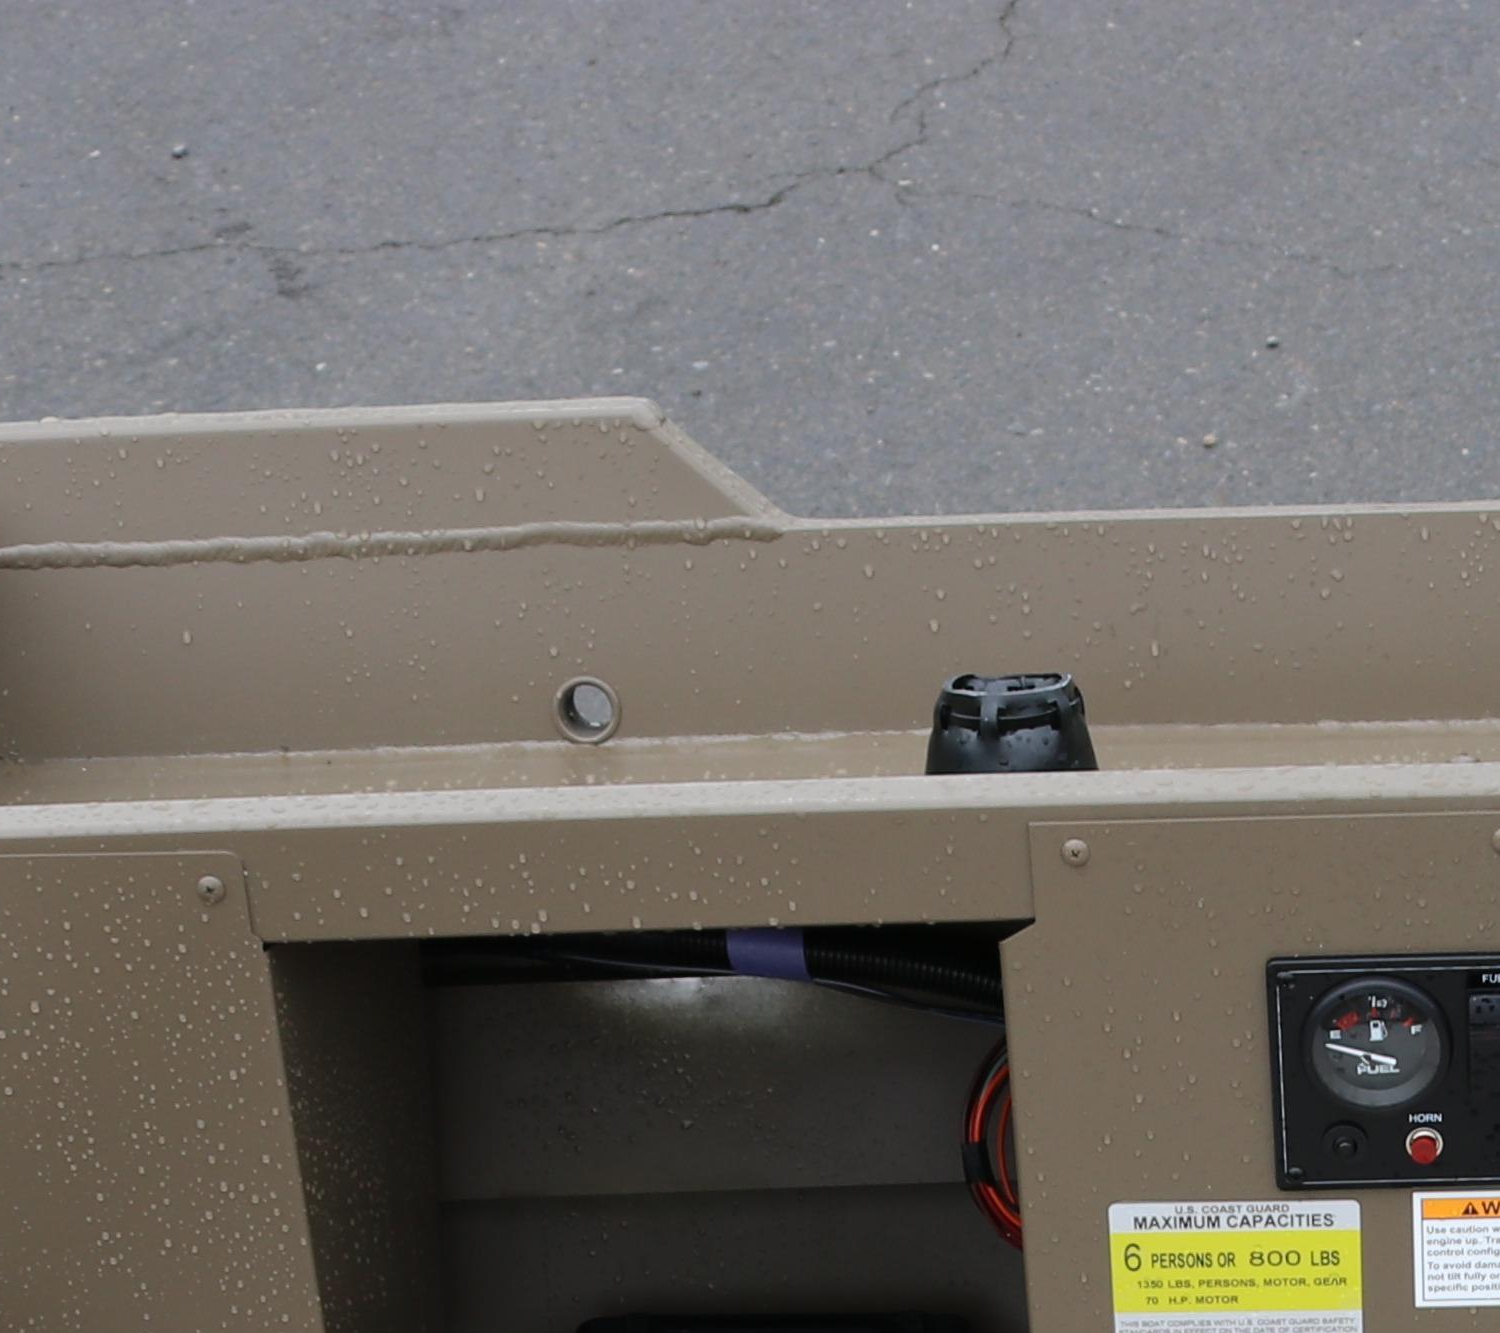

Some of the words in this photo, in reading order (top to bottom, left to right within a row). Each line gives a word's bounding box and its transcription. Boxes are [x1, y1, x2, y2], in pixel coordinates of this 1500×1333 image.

[1410, 1024, 1423, 1035] F
[1357, 1064, 1400, 1076] FUEL
[1408, 1113, 1443, 1123] HORN
[1175, 1205, 1197, 1214] U.S.
[1201, 1204, 1243, 1214] COAST
[1246, 1204, 1290, 1214] GUARD
[1133, 1215, 1221, 1230] MAXIMUM
[1226, 1213, 1334, 1229] CAPACITIES
[1426, 1225, 1446, 1234] Use
[1450, 1225, 1489, 1234] caution
[1427, 1237, 1462, 1246] engine
[1124, 1243, 1142, 1272] 6
[1151, 1252, 1213, 1269] PERSONS
[1217, 1252, 1236, 1268] OR
[1249, 1250, 1301, 1267] 800
[1310, 1250, 1340, 1267] LBS
[1427, 1248, 1464, 1257] control
[1427, 1261, 1440, 1270] To
[1443, 1261, 1472, 1269] avoid
[1427, 1272, 1444, 1281] not
[1447, 1272, 1461, 1280] tilt
[1464, 1271, 1486, 1282] fully
[1137, 1280, 1164, 1289] 1350
[1313, 1276, 1347, 1287] GEAR
[1428, 1283, 1468, 1293] specific
[1146, 1296, 1159, 1305] 70
[1168, 1296, 1191, 1305] H.P.
[1195, 1295, 1239, 1304] MOTOR
[1120, 1320, 1139, 1329] THIS
[1141, 1320, 1164, 1328] BOAT
[1167, 1319, 1212, 1328] COMPLIES
[1214, 1319, 1236, 1327] WITH
[1257, 1318, 1287, 1326] COAST
[1288, 1318, 1320, 1326] GUARD
[1322, 1317, 1354, 1325] SAFETY
[1278, 1326, 1290, 1333] OF
[1292, 1325, 1358, 1333] CERTIFICATION
